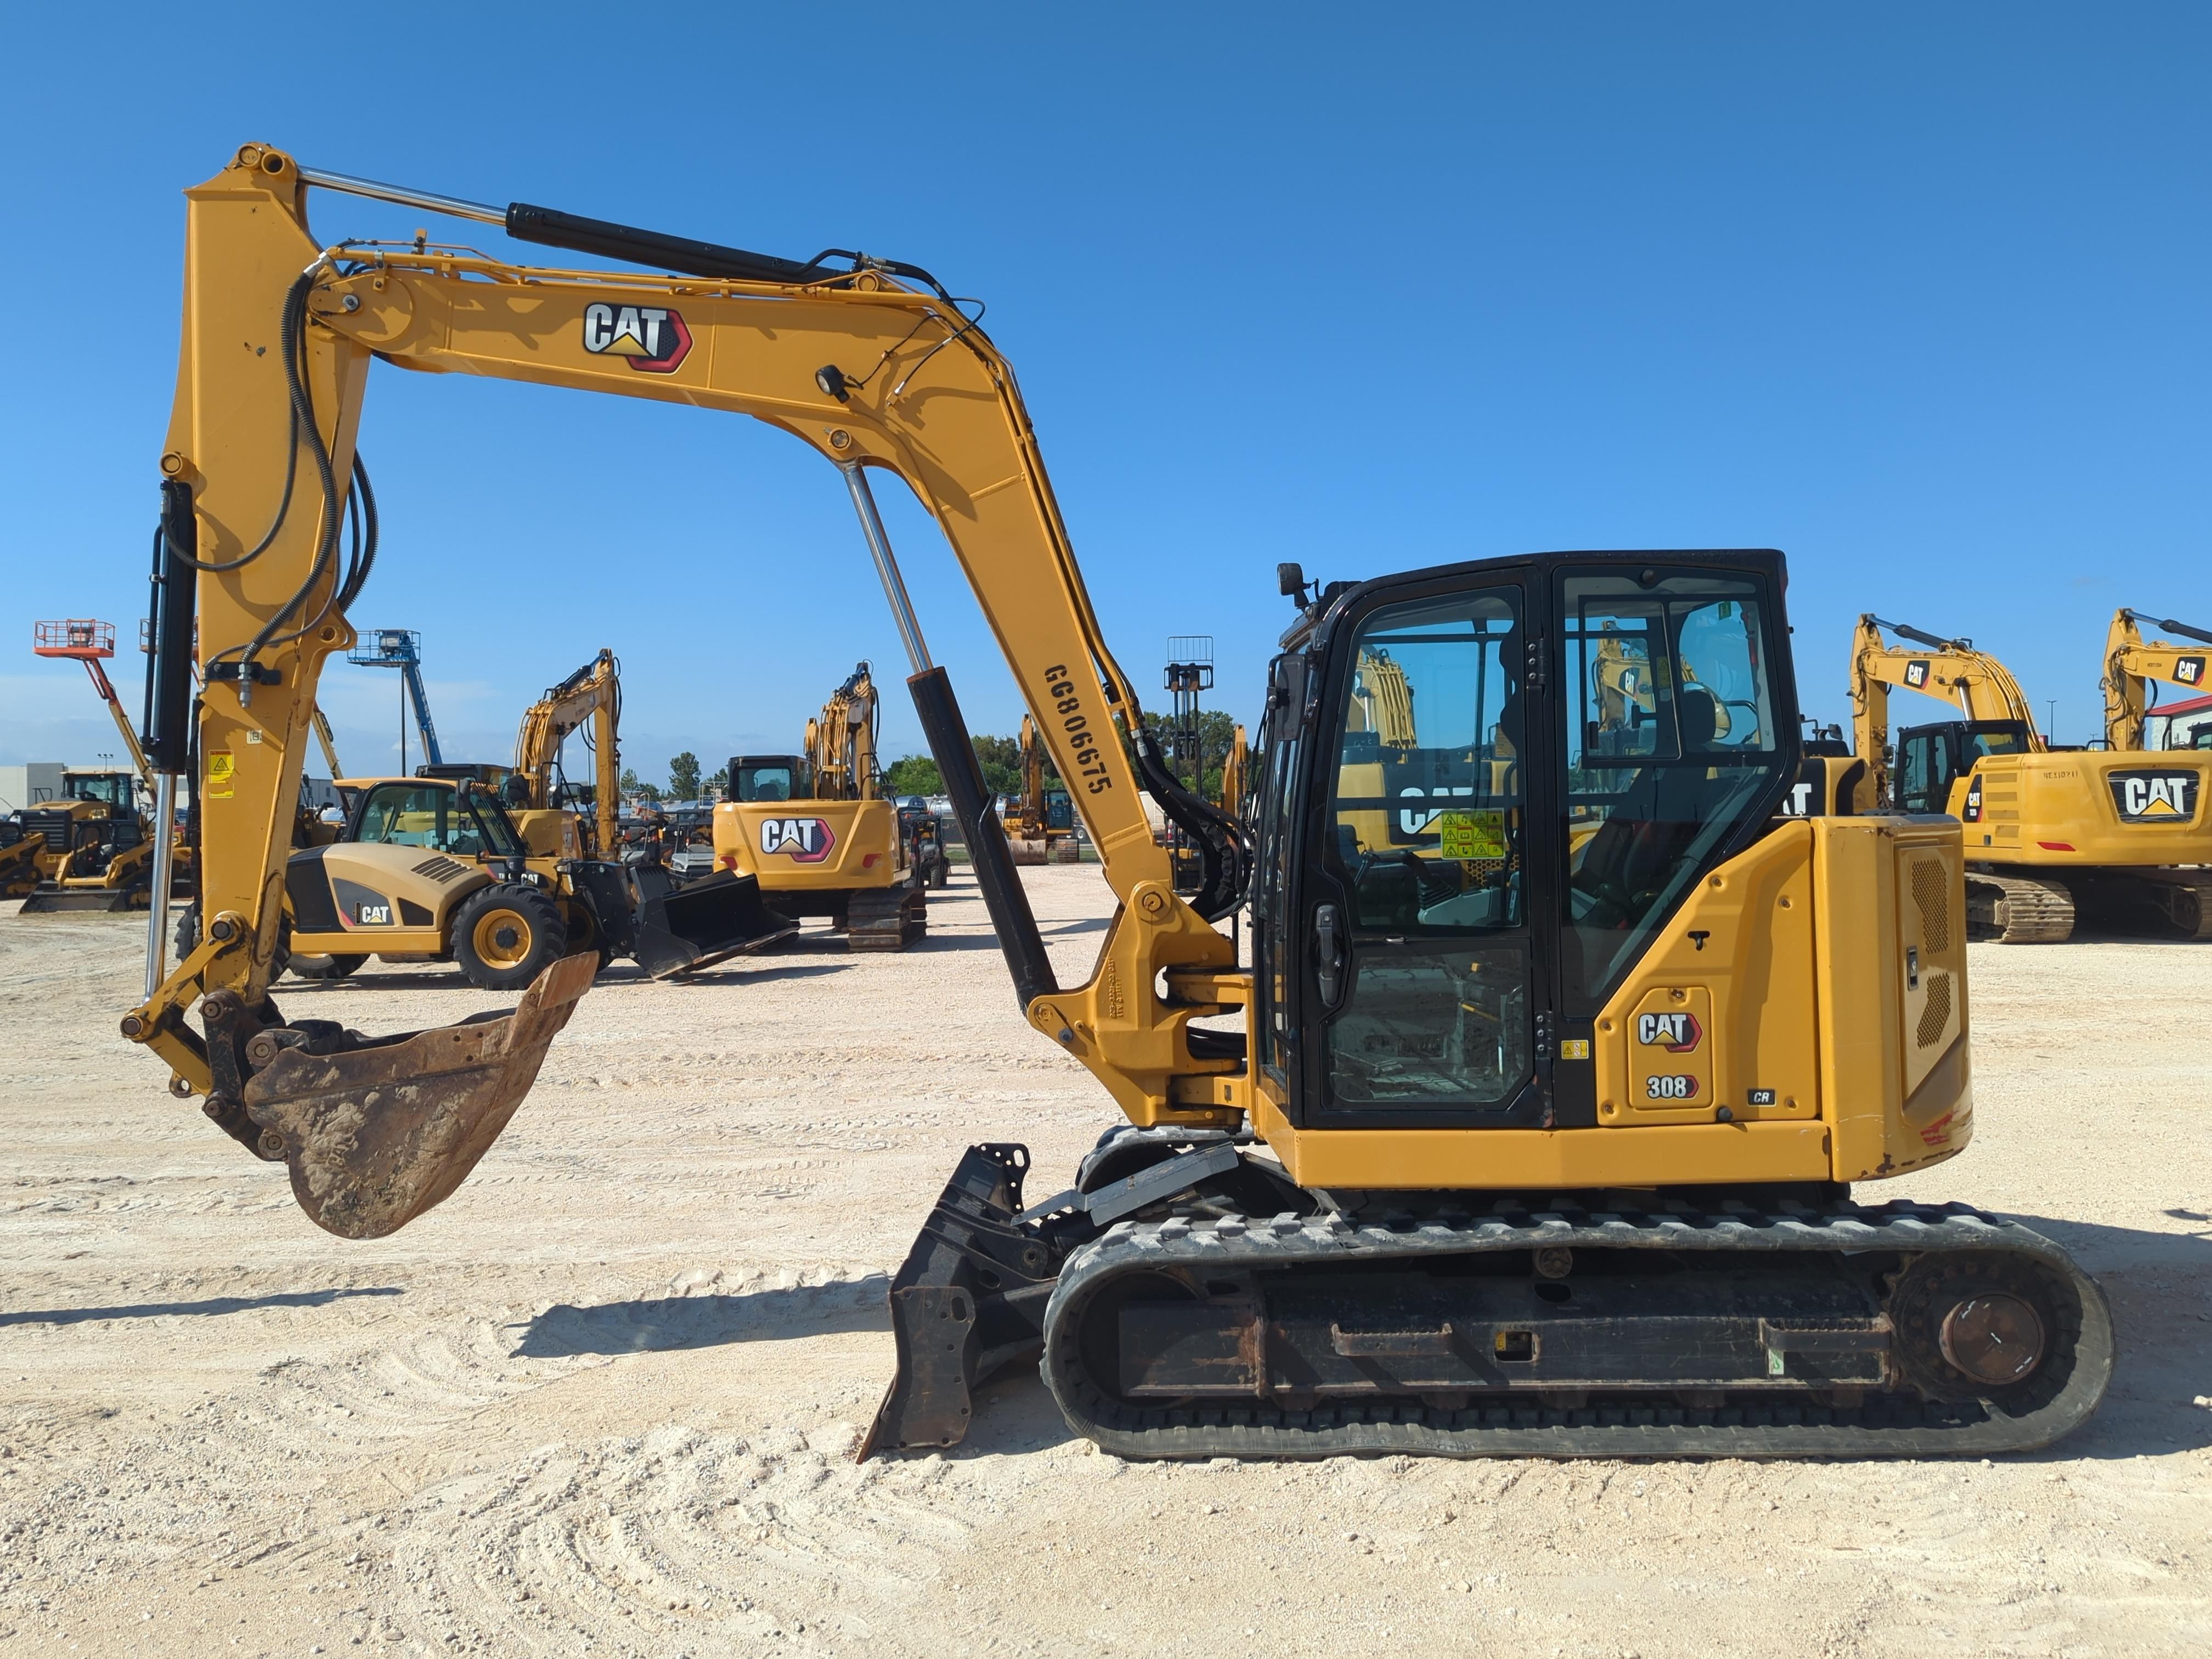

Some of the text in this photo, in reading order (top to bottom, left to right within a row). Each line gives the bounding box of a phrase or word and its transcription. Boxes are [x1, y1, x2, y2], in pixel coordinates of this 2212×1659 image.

[585, 304, 667, 357] CAT
[1908, 664, 1923, 685] CAT
[2179, 661, 2197, 681] CAT
[1625, 672, 1634, 694] CAT
[1045, 664, 1112, 794] GG806675
[1968, 792, 1980, 806] CAT
[2125, 777, 2187, 815] CAT
[762, 820, 816, 853] CAT
[521, 873, 539, 885] CAT
[362, 906, 388, 923] CAT
[1639, 1014, 1686, 1044] CAT
[1647, 1076, 1686, 1098] 308
[1754, 1092, 1770, 1103] CR
